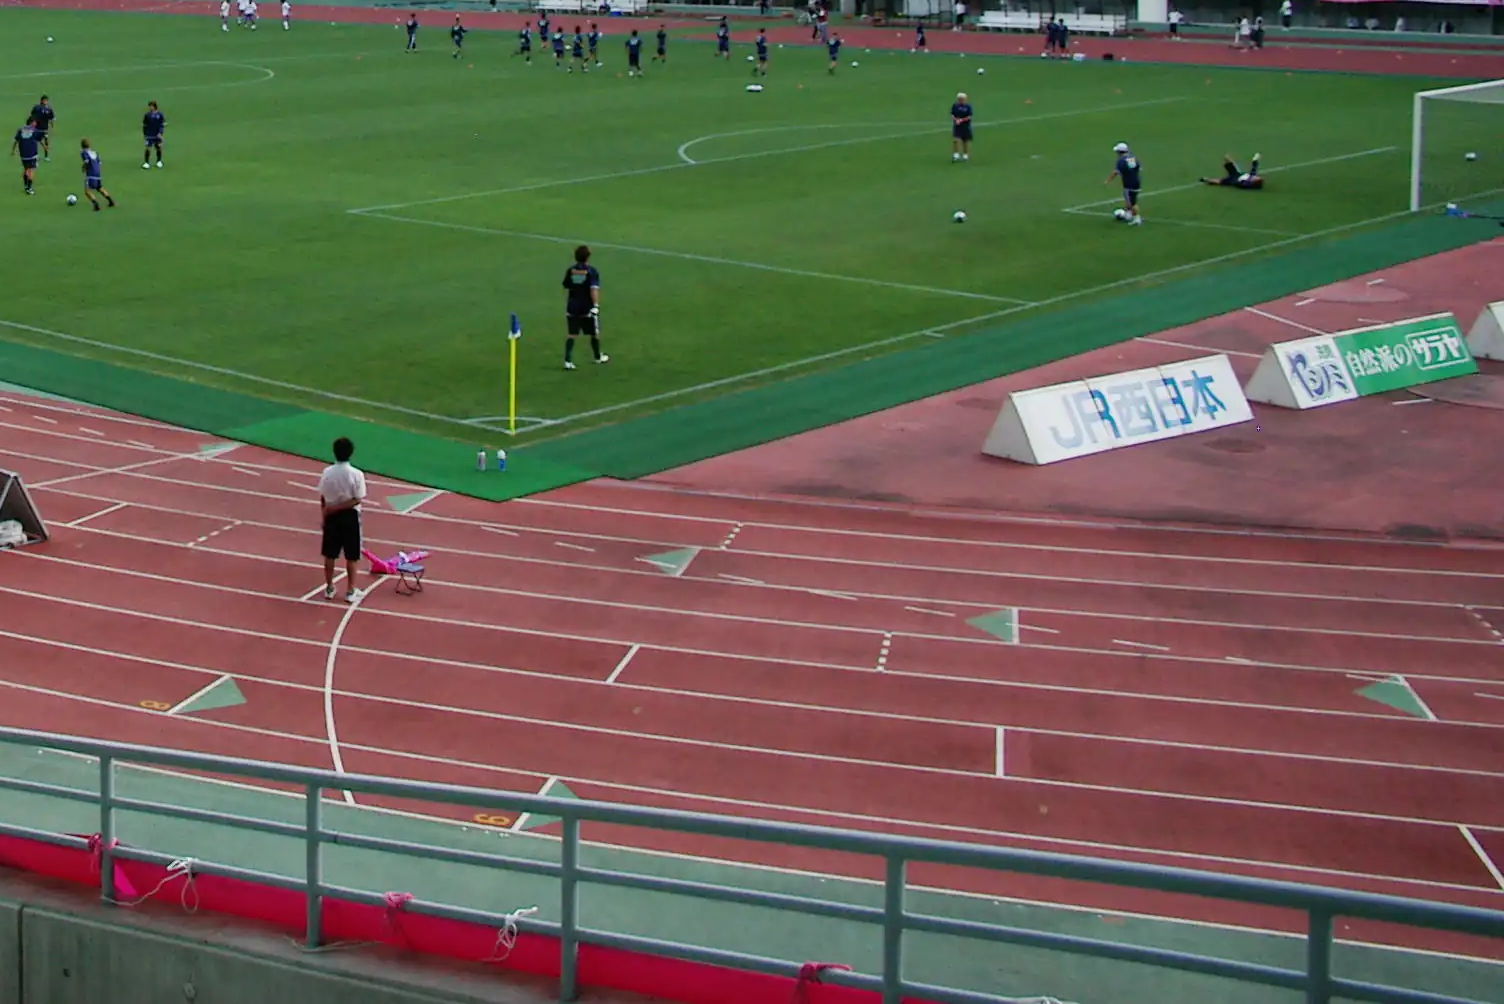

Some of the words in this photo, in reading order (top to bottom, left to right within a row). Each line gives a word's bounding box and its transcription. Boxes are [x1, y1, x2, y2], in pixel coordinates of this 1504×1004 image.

[1411, 334, 1463, 365] サラヤ
[1049, 370, 1227, 449] JR西日本
[139, 699, 171, 711] 8
